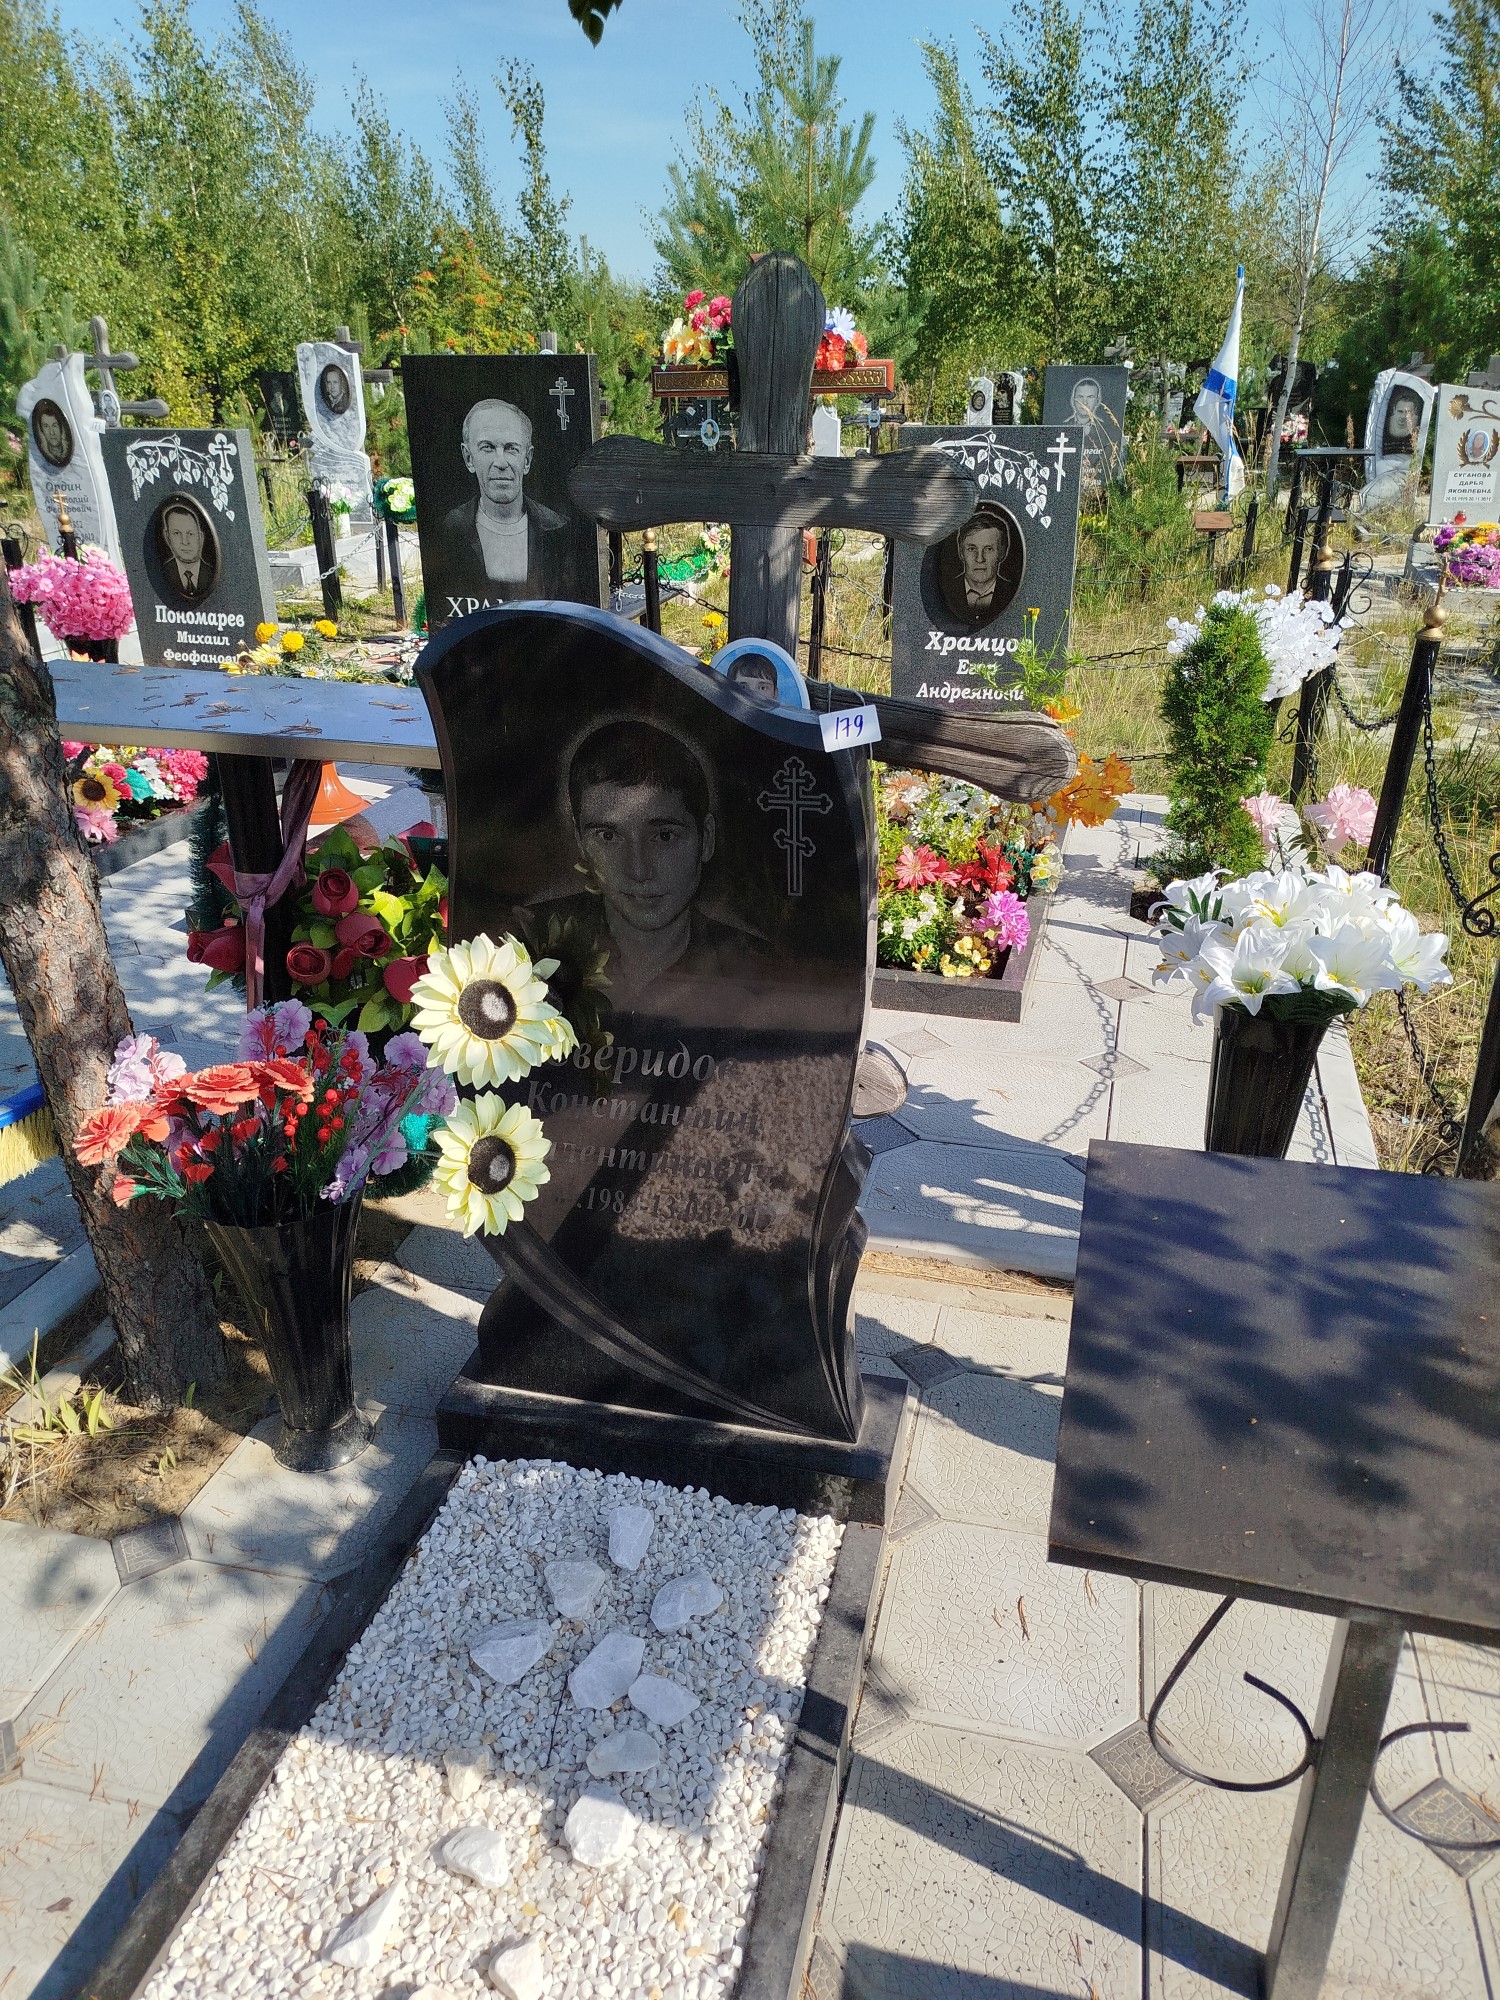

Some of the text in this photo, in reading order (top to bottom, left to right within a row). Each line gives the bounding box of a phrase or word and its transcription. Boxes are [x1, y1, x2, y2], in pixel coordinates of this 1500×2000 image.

[45, 480, 82, 493] Ордин
[154, 604, 246, 632] Пономарев
[445, 597, 504, 618] ХРА
[176, 630, 231, 647] Михаил
[163, 648, 240, 666] Феофанови
[835, 714, 864, 740] 179
[528, 1079, 759, 1137] Константин
[549, 1142, 773, 1184] лентинович
